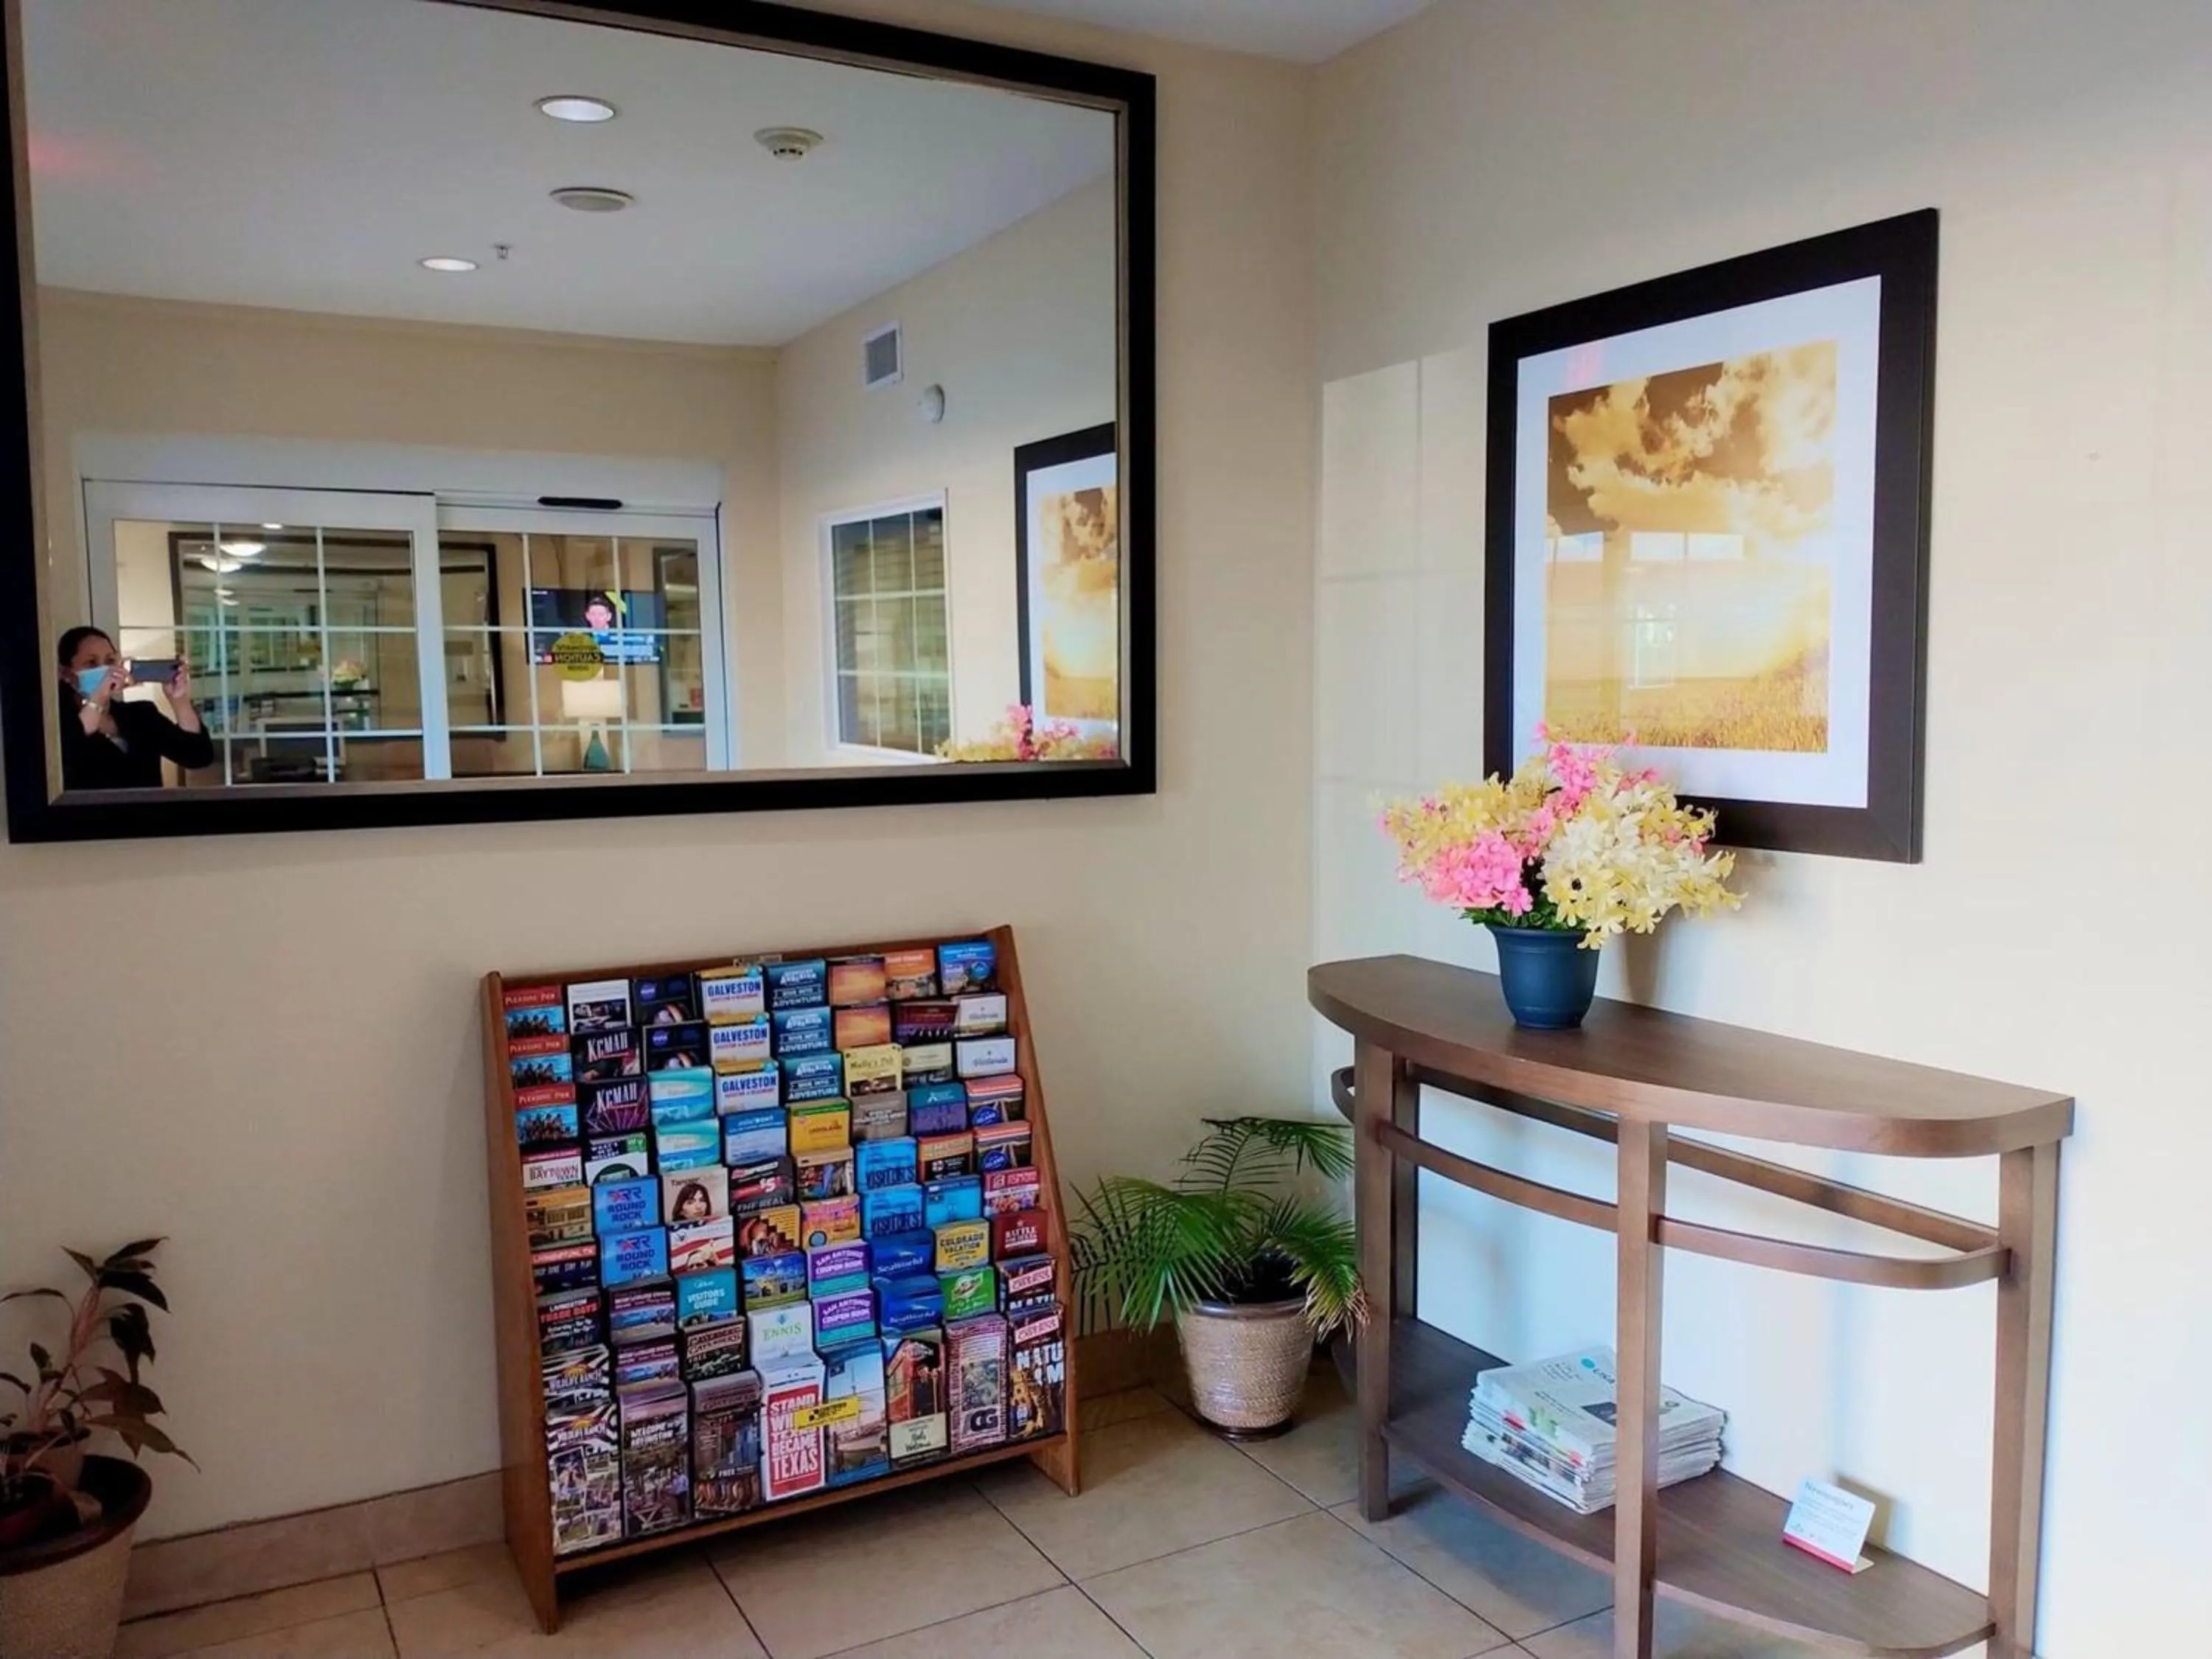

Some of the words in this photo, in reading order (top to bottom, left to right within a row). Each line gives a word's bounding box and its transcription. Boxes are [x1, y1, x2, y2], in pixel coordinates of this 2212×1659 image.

[707, 981, 761, 997] GALVESTON
[773, 995, 822, 1007] ADVENTURE
[713, 1028, 768, 1044] GALVESTON
[779, 1041, 828, 1053] ADVENTURE
[722, 1076, 776, 1093] GALVESTON
[787, 1087, 838, 1100] ADVENTURE
[608, 1200, 646, 1213] ROUND
[611, 1210, 642, 1222] ROCK
[940, 1233, 984, 1247] COLORADO
[945, 1242, 981, 1253] VACATION
[616, 1250, 655, 1262] ROUND
[621, 1259, 651, 1271] ROCK
[877, 1256, 924, 1273] SeaWorld
[687, 1289, 725, 1304] VISITORS
[540, 1308, 571, 1323] TRADE
[762, 1324, 801, 1341] ENNIS
[770, 1393, 816, 1416] STAND
[772, 1432, 818, 1454] BECAME
[771, 1447, 818, 1481] TEXAS
